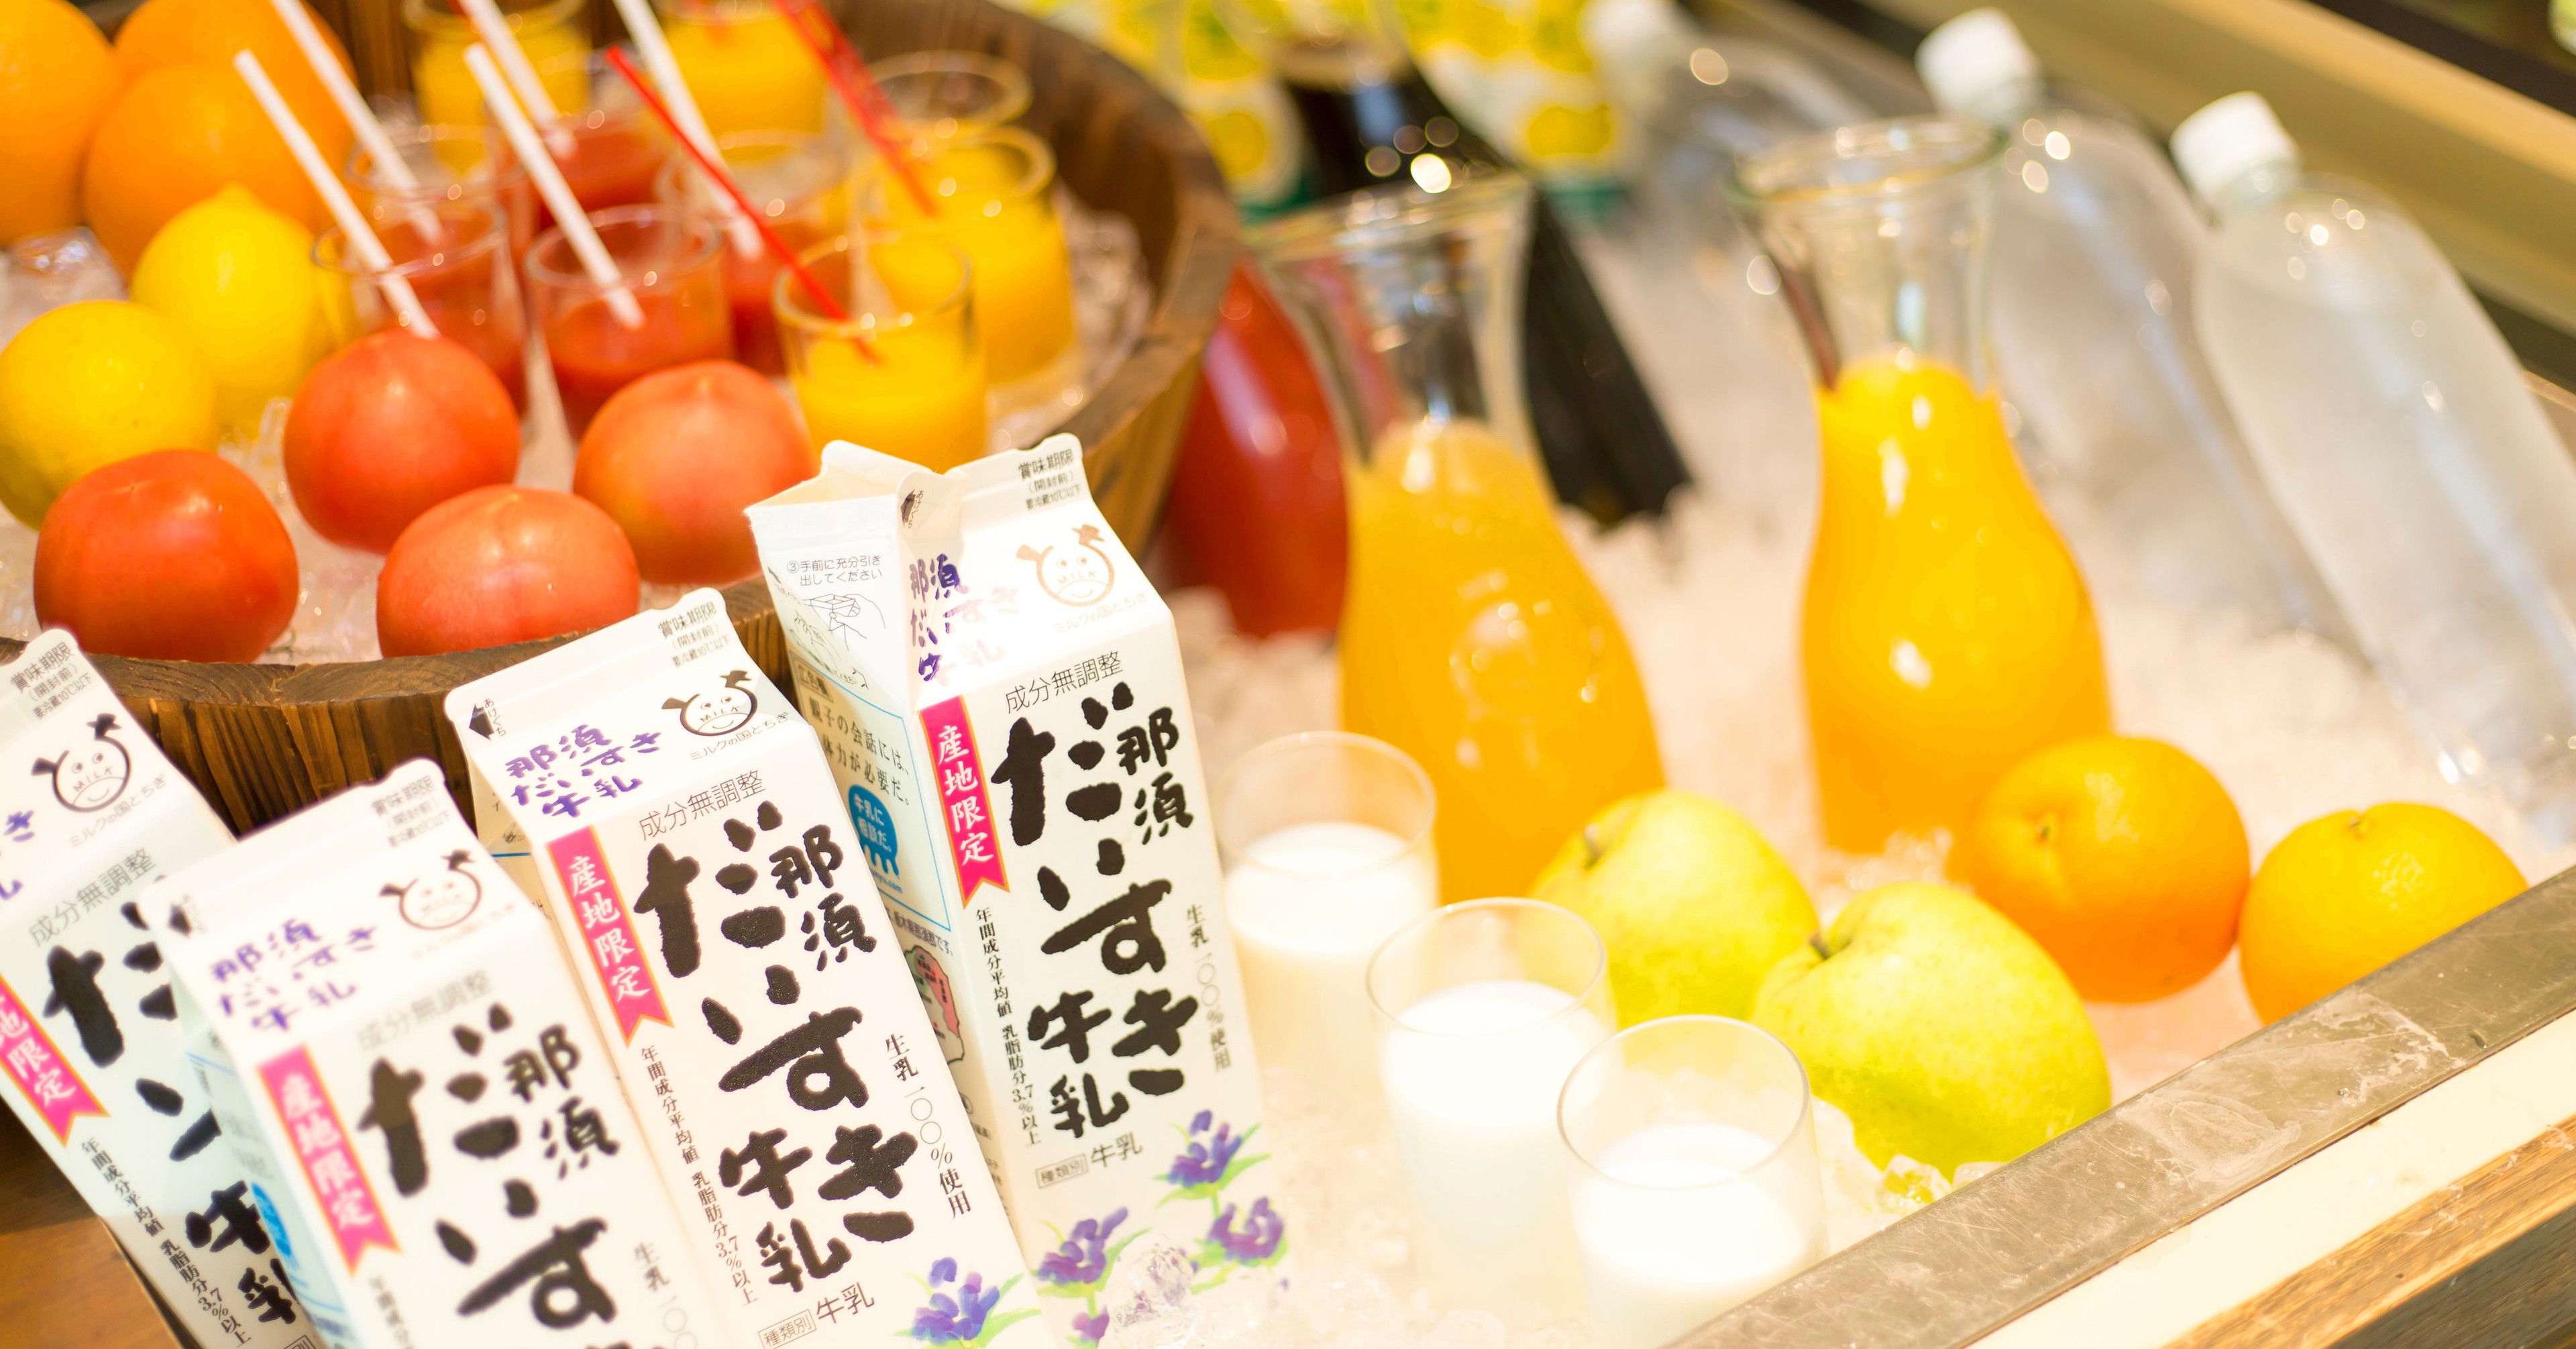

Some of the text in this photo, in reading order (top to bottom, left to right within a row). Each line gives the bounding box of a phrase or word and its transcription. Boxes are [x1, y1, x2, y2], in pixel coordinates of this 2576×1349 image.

[1018, 448, 1074, 481] 賞味期限
[800, 568, 883, 587] 出してください
[658, 601, 718, 639] 賞味期限
[10, 641, 74, 694] 賞味期限
[1005, 650, 1124, 714] 成分無調整
[690, 711, 789, 761] ミルクの国とちぎ
[699, 705, 741, 722] MILK
[72, 765, 114, 793] MILK
[504, 724, 612, 778] 那須
[511, 731, 662, 806] だいすき
[1117, 706, 1194, 845] 那須
[68, 773, 167, 849] ミルクの国とちぎ
[542, 775, 644, 818] 牛乳
[639, 769, 766, 842] 成分無調整
[937, 724, 994, 867] 産地限定
[28, 847, 158, 948] 成分無調整
[568, 855, 652, 1004] 産地限定
[769, 823, 877, 972] 那須
[633, 800, 918, 1242] だいすき
[1028, 989, 1130, 1138] 牛乳
[503, 1023, 622, 1182] 那須
[640, 1046, 700, 1165] 年間成分平均値
[1040, 1132, 1143, 1184] 種類別 牛乳
[718, 1127, 852, 1293] 牛乳
[762, 1282, 875, 1347] 種類別 牛乳
